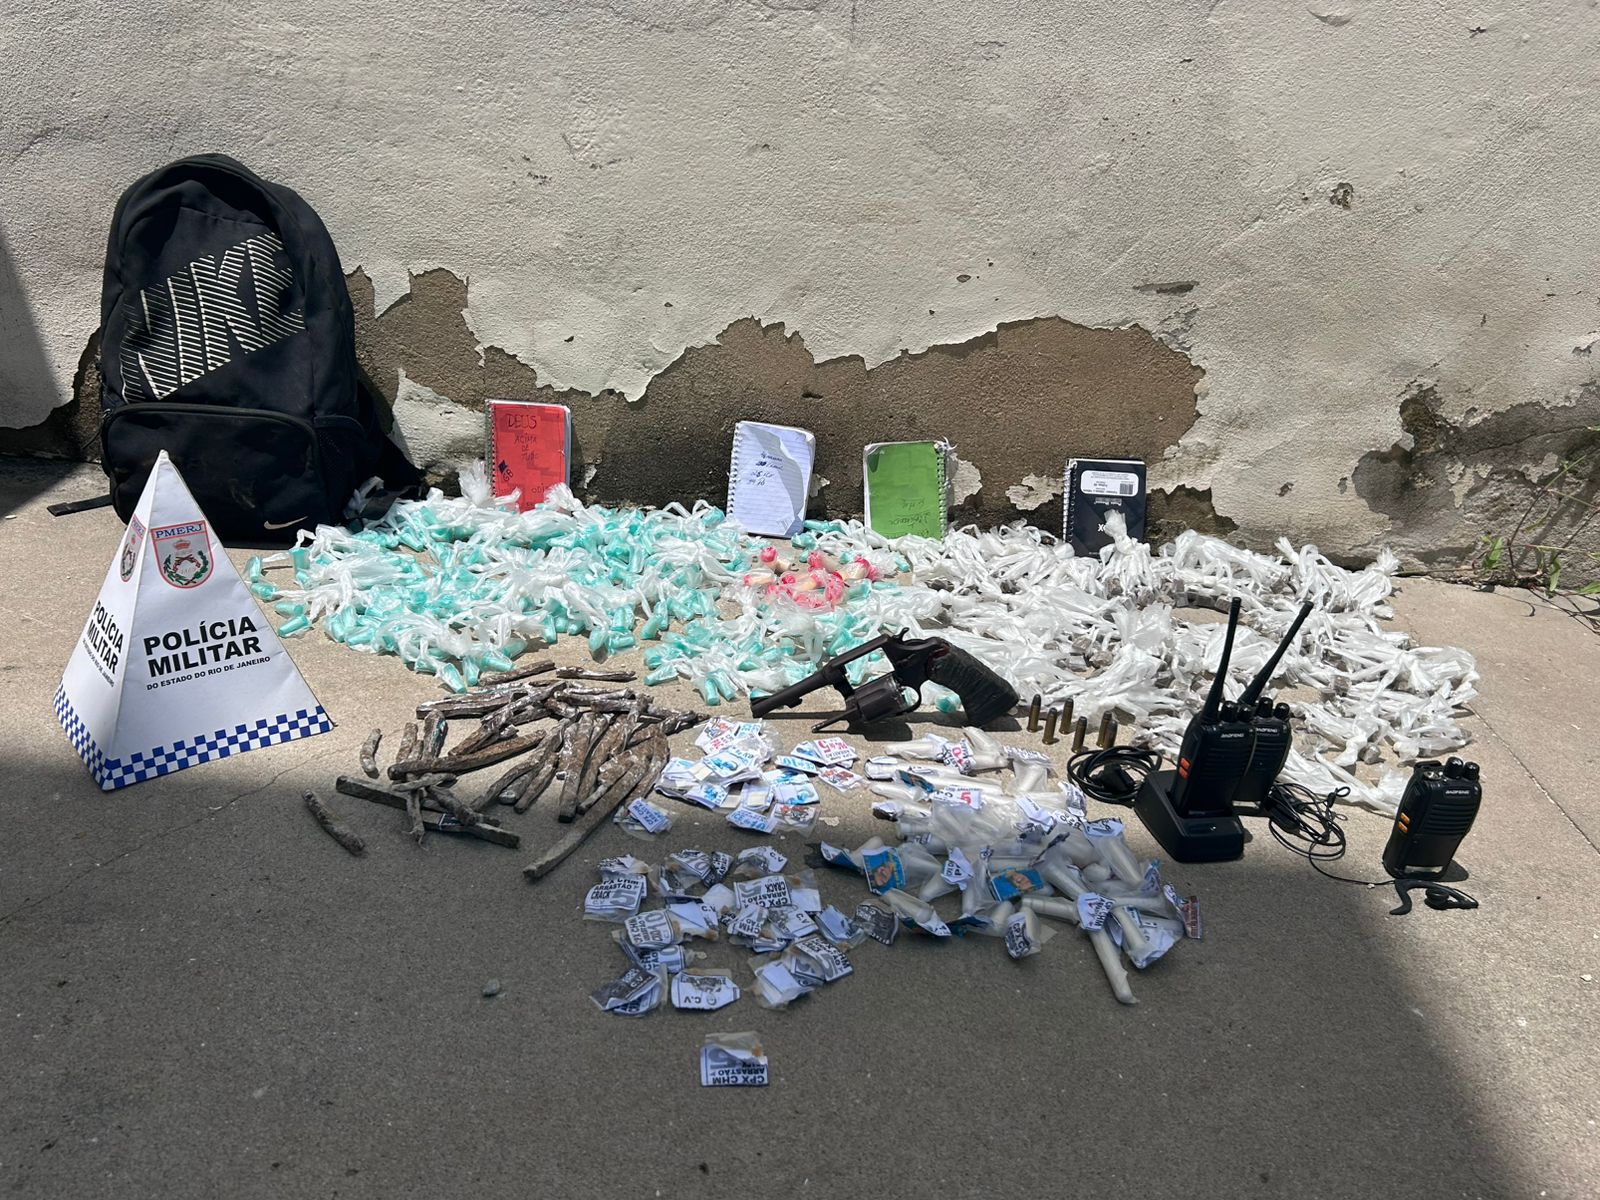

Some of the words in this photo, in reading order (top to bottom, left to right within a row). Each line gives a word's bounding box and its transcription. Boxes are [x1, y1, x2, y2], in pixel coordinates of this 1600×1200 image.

[507, 414, 538, 430] DEUS
[155, 523, 203, 540] PMERJ
[93, 600, 124, 654] POLÍCIA
[143, 615, 258, 656] POLÍCIA
[86, 619, 119, 675] MILITAR
[147, 636, 263, 678] MILITAR
[146, 682, 159, 691] DO
[160, 676, 193, 689] ESTADO
[194, 672, 207, 681] DO
[208, 667, 223, 678] RIO
[224, 664, 235, 675] DE
[236, 656, 271, 672] JANEIRO
[764, 881, 786, 893] CRACK
[768, 897, 788, 908] CPX
[683, 996, 702, 1005] C.V
[717, 1067, 765, 1077] ARRASTÃO
[741, 1075, 765, 1084] CPX
[712, 1076, 738, 1085] CHM
